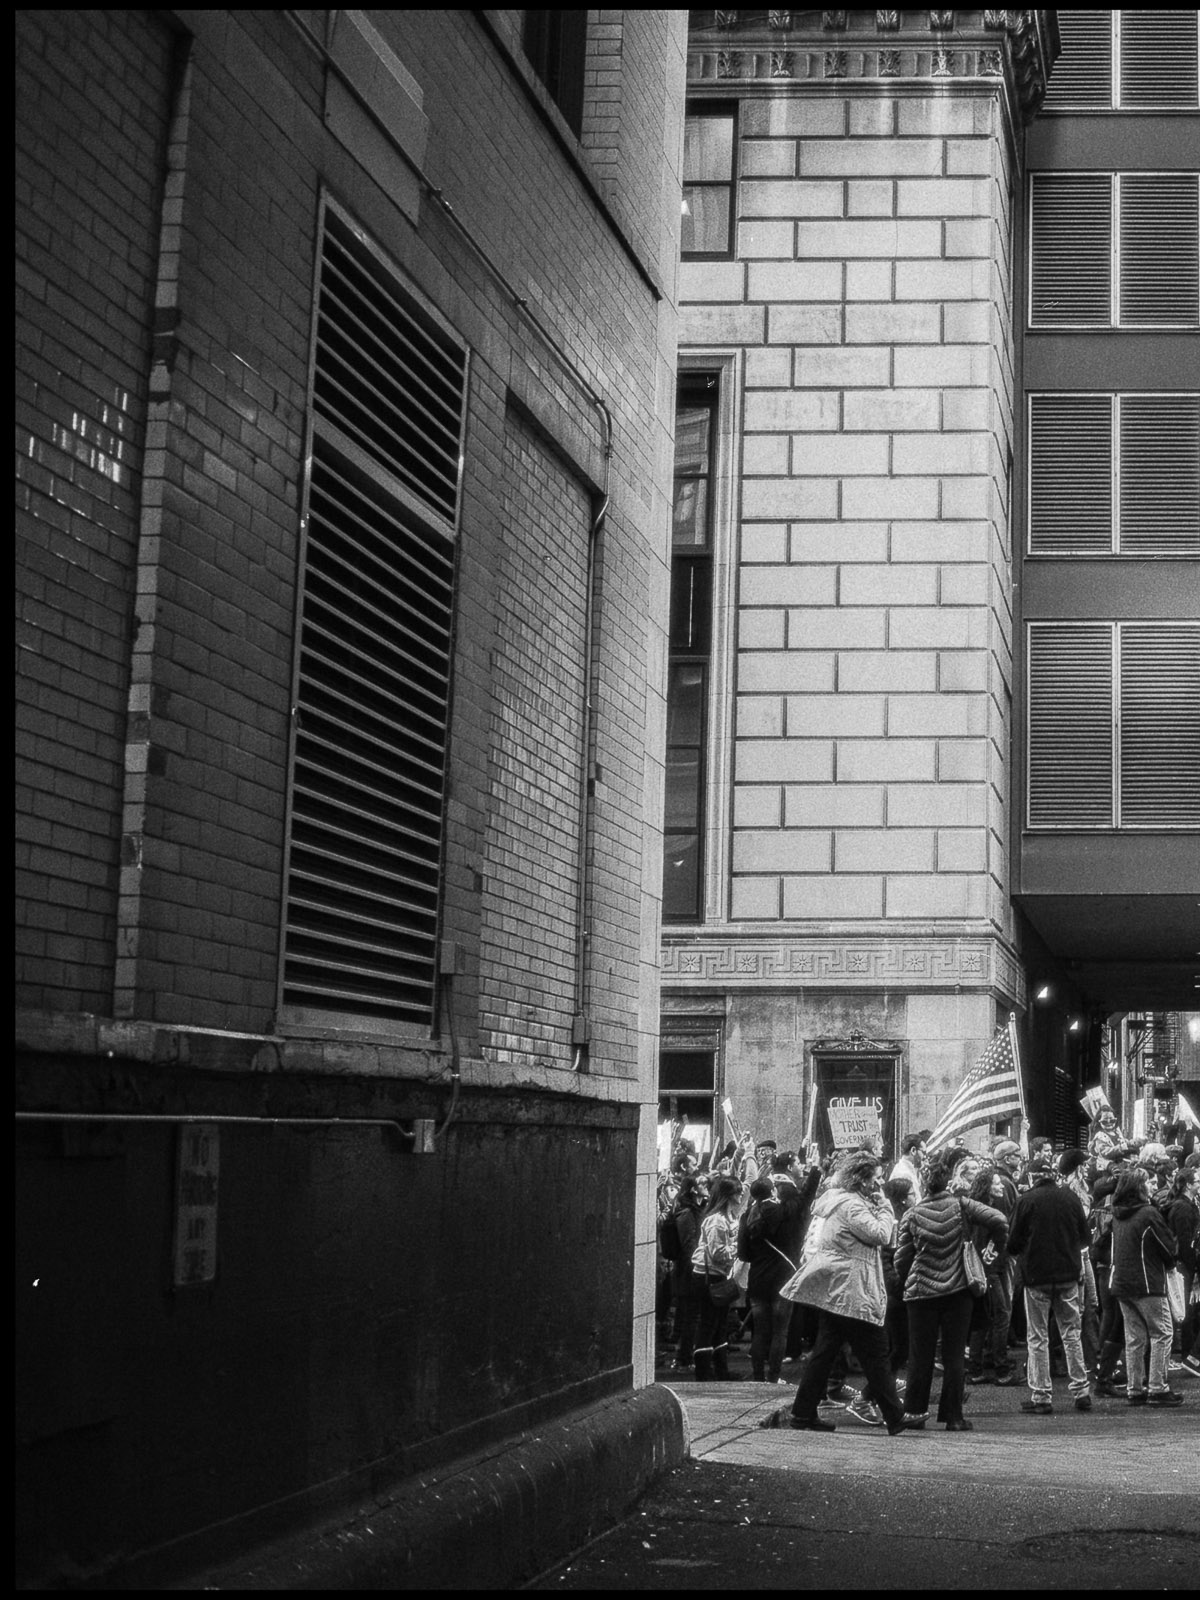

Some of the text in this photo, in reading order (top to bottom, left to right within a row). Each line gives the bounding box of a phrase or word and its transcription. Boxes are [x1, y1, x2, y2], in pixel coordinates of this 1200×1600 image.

[830, 1097, 883, 1113] GIVE US
[839, 1120, 868, 1133] TRUST
